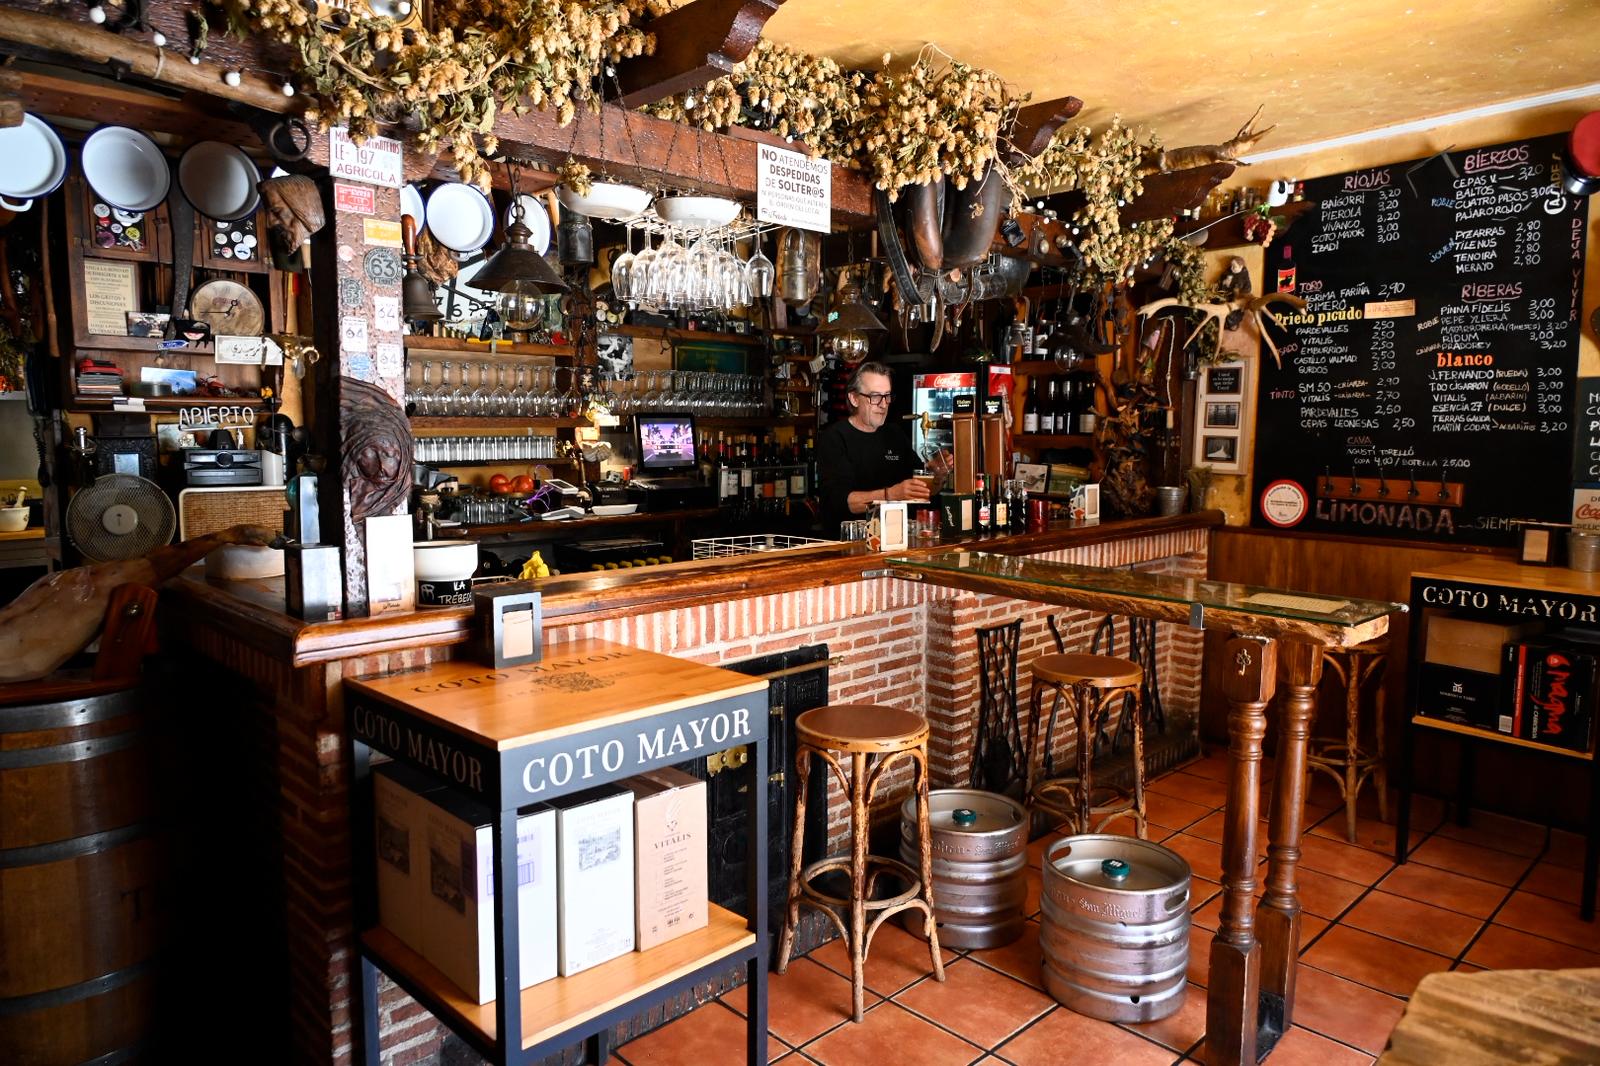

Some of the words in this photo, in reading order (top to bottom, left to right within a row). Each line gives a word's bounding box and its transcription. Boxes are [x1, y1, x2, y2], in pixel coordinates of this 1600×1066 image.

[761, 148, 777, 162] NO
[778, 154, 829, 175] ATENDEMOS
[1463, 145, 1529, 171] BIERZOS
[336, 163, 396, 184] AGRICOLA
[769, 164, 821, 185] DESPEDIDAS
[1344, 168, 1391, 190] RIOJAS
[1452, 174, 1487, 190] CEPAS
[1518, 163, 1544, 181] 3,20
[765, 177, 776, 188] DE
[778, 179, 825, 198] SOLTER@S
[1379, 188, 1401, 201] 3,20
[1455, 185, 1495, 200] BALTOS
[1454, 195, 1496, 210] CUATRO
[1497, 190, 1529, 204] PASOS
[1321, 206, 1362, 222] PIEROLA
[1377, 199, 1399, 212] 3,20
[1455, 206, 1495, 222] PAJARO
[1494, 201, 1523, 216] ROJO
[1322, 219, 1360, 232] VIVANCO
[1376, 211, 1400, 223] 3,20
[1515, 220, 1540, 233] 2,80
[1311, 232, 1337, 244] COTO
[1377, 222, 1399, 234] 3,00
[1377, 231, 1400, 243] 3,00
[1454, 237, 1497, 251] TILENUS
[1514, 231, 1540, 244] 2,80
[1514, 242, 1540, 255] 2,80
[370, 257, 396, 278] 63
[1455, 261, 1494, 275] MERAYO
[1513, 253, 1541, 266] 2,80
[1340, 281, 1370, 298] FARIÑA
[1378, 281, 1405, 298] 2,90
[1461, 281, 1523, 299] RIBERAS
[452, 303, 463, 317] 6
[1440, 304, 1470, 316] PINNA
[1472, 300, 1512, 314] FIDELIS
[1528, 298, 1556, 310] 3,00
[1317, 306, 1363, 326] picudo
[1440, 315, 1464, 326] PEPE
[1529, 309, 1555, 321] 3,00
[1372, 321, 1395, 331] 2,50
[1546, 321, 1568, 332] 3,20
[1301, 335, 1334, 345] VITALIS
[1371, 330, 1395, 341] 2,50
[1529, 330, 1554, 342] 3,00
[1540, 339, 1567, 350] 3,20
[1370, 340, 1394, 351] 2,50
[1371, 350, 1396, 361] 2,50
[1436, 352, 1494, 368] blanco
[1372, 361, 1396, 371] 3,00
[1536, 367, 1562, 378] 3,00
[1270, 387, 1296, 400] TINTO
[1298, 382, 1315, 393] SM
[1317, 381, 1332, 393] 50
[1376, 377, 1400, 387] 2,90
[1537, 381, 1563, 391] 3,00
[1300, 390, 1331, 403] VITALIS
[1432, 393, 1467, 402] VITALIS
[1537, 393, 1561, 403] 3,00
[179, 406, 254, 426] ABIERTO
[1374, 404, 1401, 416] 2,50
[1431, 402, 1470, 413] ESENCIA
[1470, 401, 1483, 412] 27
[1537, 403, 1562, 414] 3,00
[1300, 419, 1328, 428] CEPAS
[1334, 419, 1380, 429] LEONESAS
[1392, 417, 1416, 431] 2,50
[1432, 414, 1465, 423] TERRAS
[1540, 421, 1567, 434] 3,20
[1315, 498, 1455, 534] LIMONADA
[1422, 585, 1489, 609] COTO
[1498, 593, 1597, 623] MAYOR
[410, 672, 510, 694] COTO
[518, 651, 632, 673] MAYOR
[353, 704, 400, 752] COTO
[406, 727, 485, 793] MAYOR
[521, 738, 625, 794] COTO
[636, 706, 752, 765] MAYOR
[653, 832, 692, 849] VITALIS
